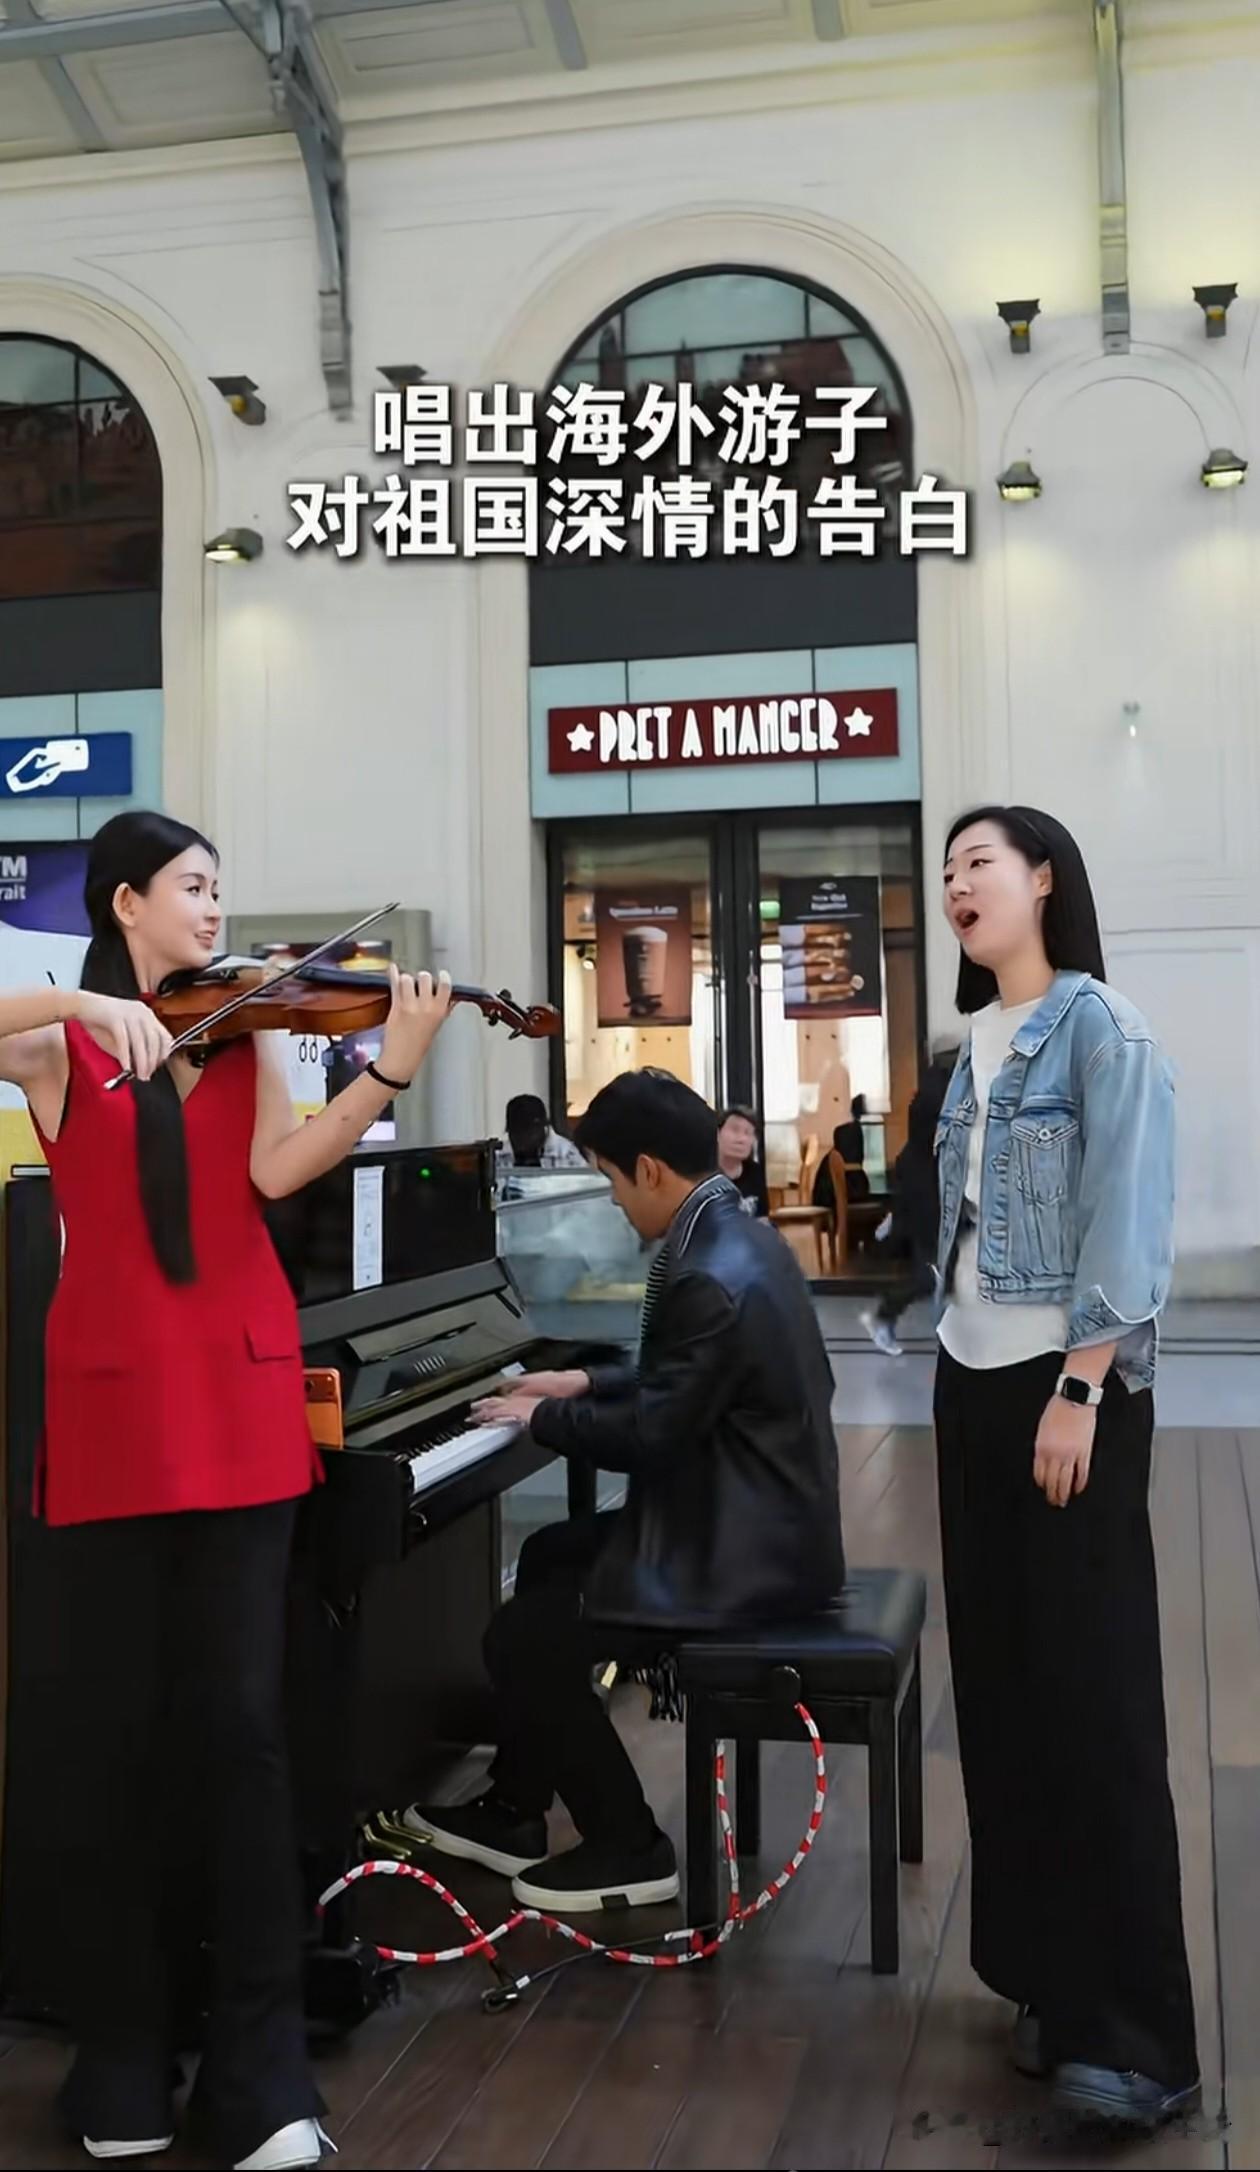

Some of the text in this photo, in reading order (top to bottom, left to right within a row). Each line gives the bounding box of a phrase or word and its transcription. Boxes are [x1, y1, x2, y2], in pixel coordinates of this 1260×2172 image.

[599, 697, 839, 763] PRET A MANGER
